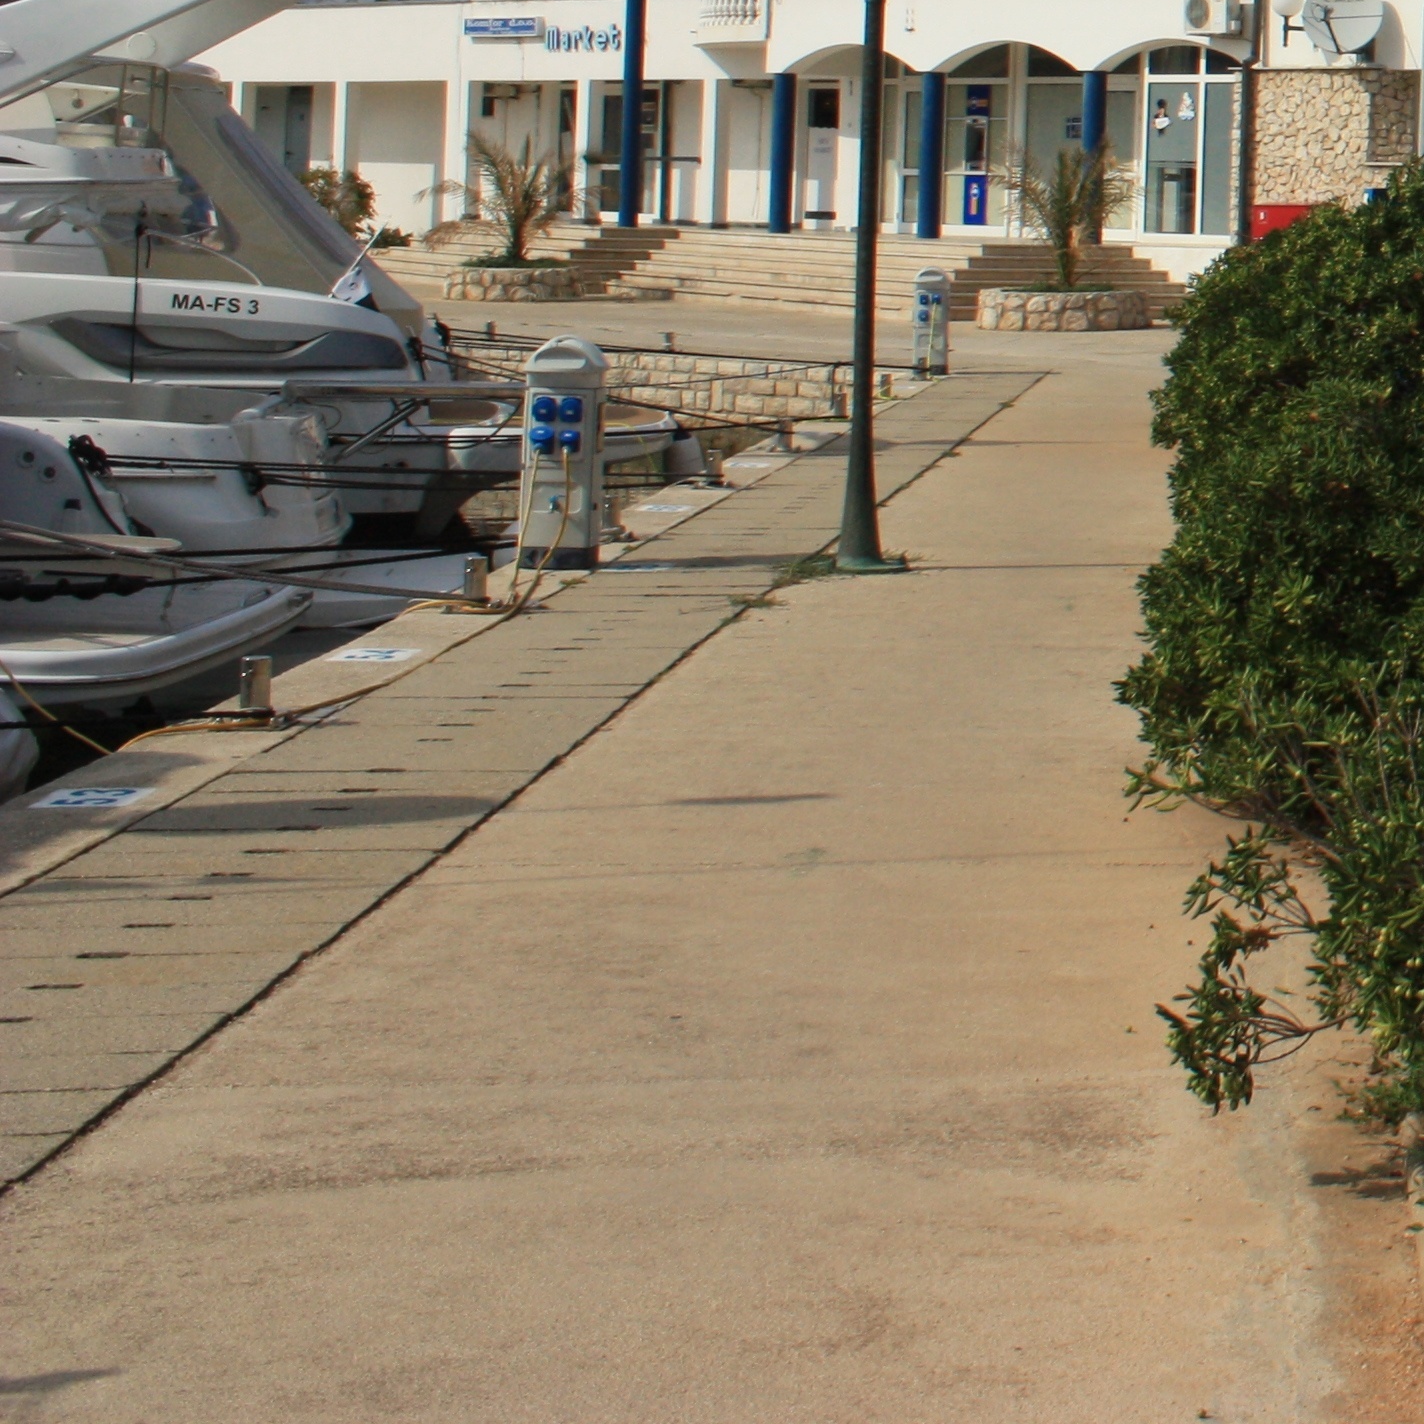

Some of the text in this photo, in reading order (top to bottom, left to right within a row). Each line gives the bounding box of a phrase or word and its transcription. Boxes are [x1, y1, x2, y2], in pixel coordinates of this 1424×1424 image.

[546, 23, 621, 52] Market
[172, 293, 260, 315] MA-FS 3
[50, 788, 137, 806] 53
